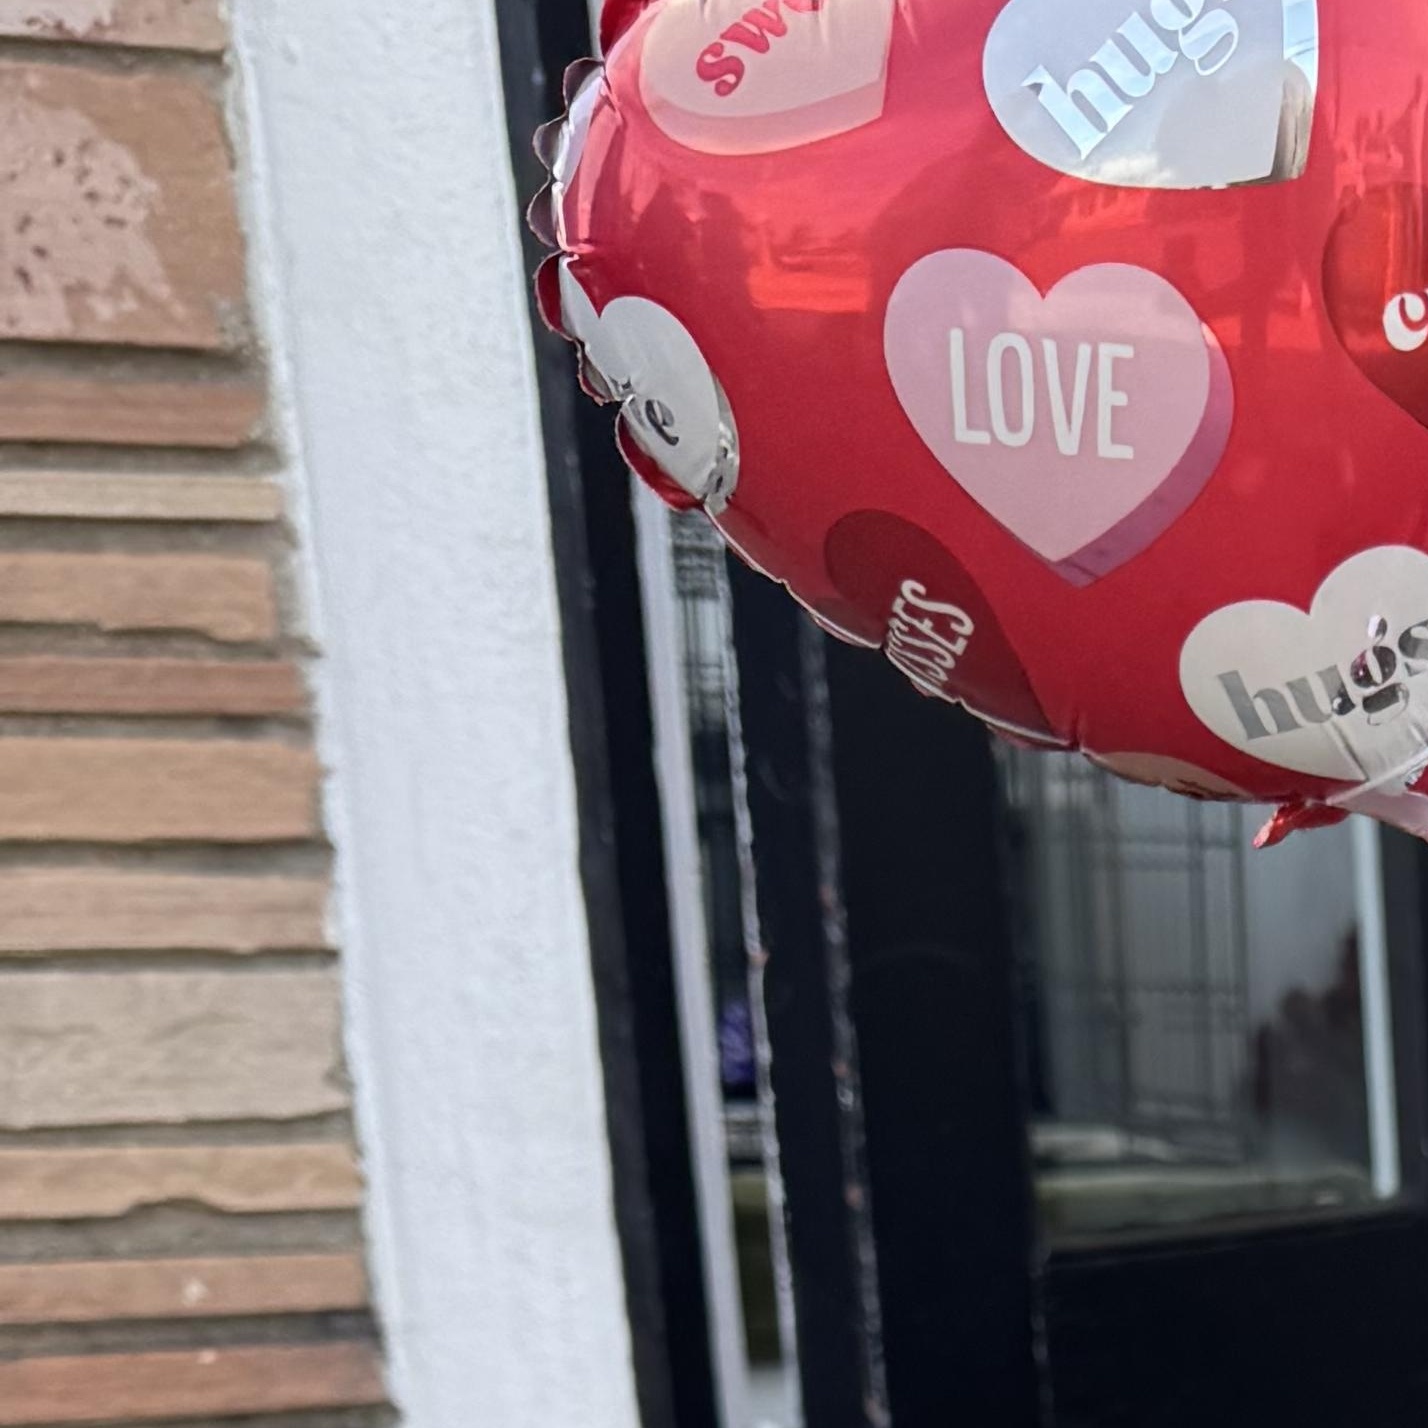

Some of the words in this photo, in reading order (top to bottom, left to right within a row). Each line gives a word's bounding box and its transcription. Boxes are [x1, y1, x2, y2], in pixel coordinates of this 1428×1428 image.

[697, 0, 818, 97] sw
[1020, 0, 1239, 160] hug
[949, 327, 1135, 459] LOVE
